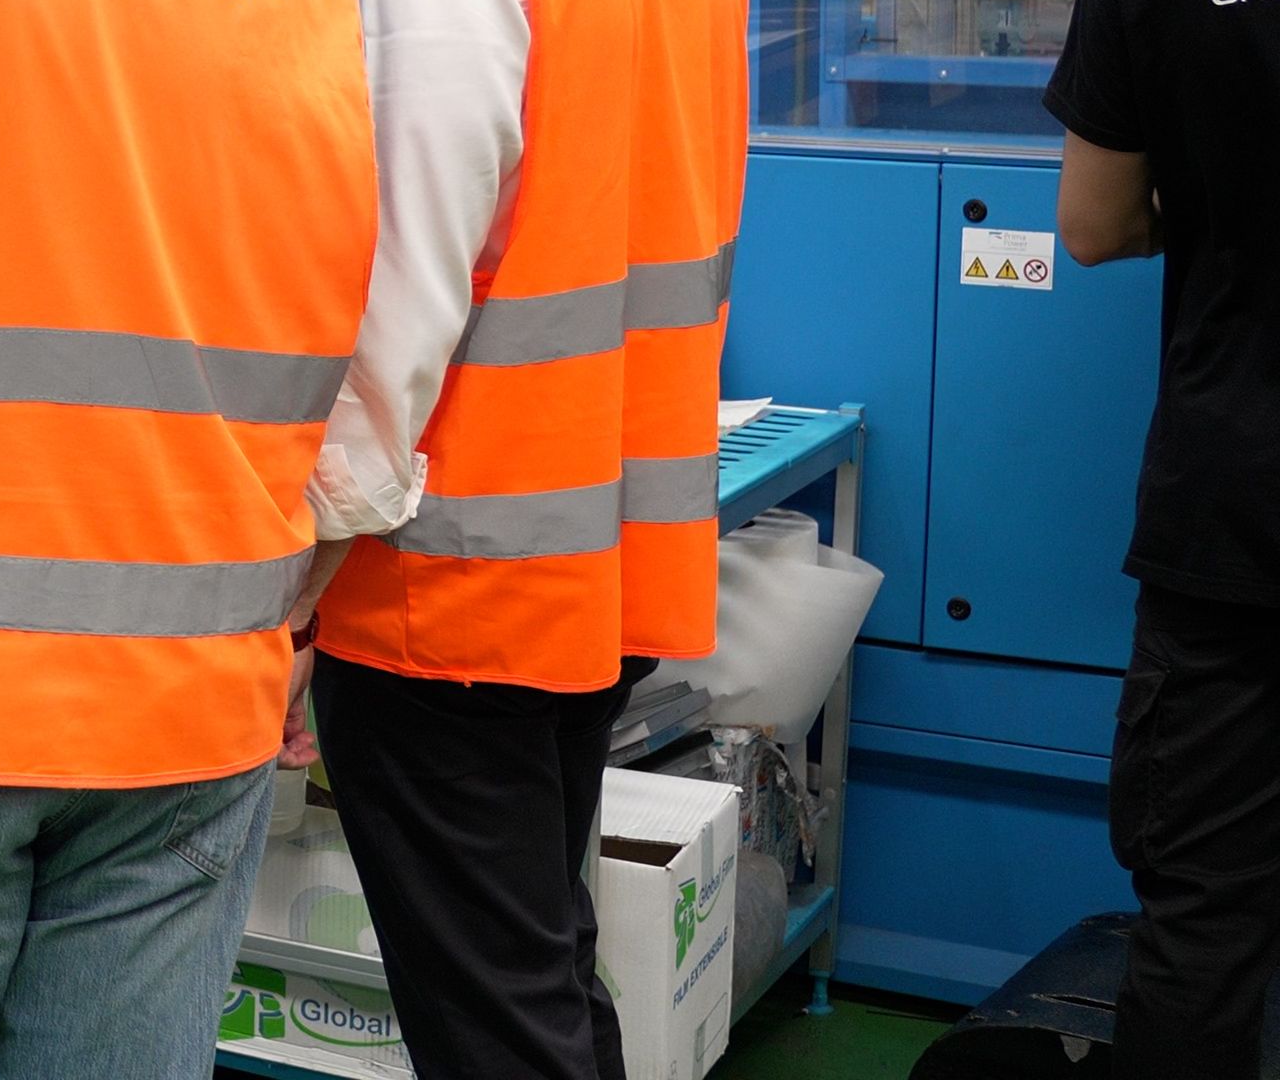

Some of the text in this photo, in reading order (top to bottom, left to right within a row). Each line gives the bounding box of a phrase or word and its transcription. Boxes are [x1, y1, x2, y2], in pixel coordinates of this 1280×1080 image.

[699, 866, 721, 908] Global
[673, 925, 729, 1011] FILM EXTENSIBLE
[300, 998, 391, 1037] Global
